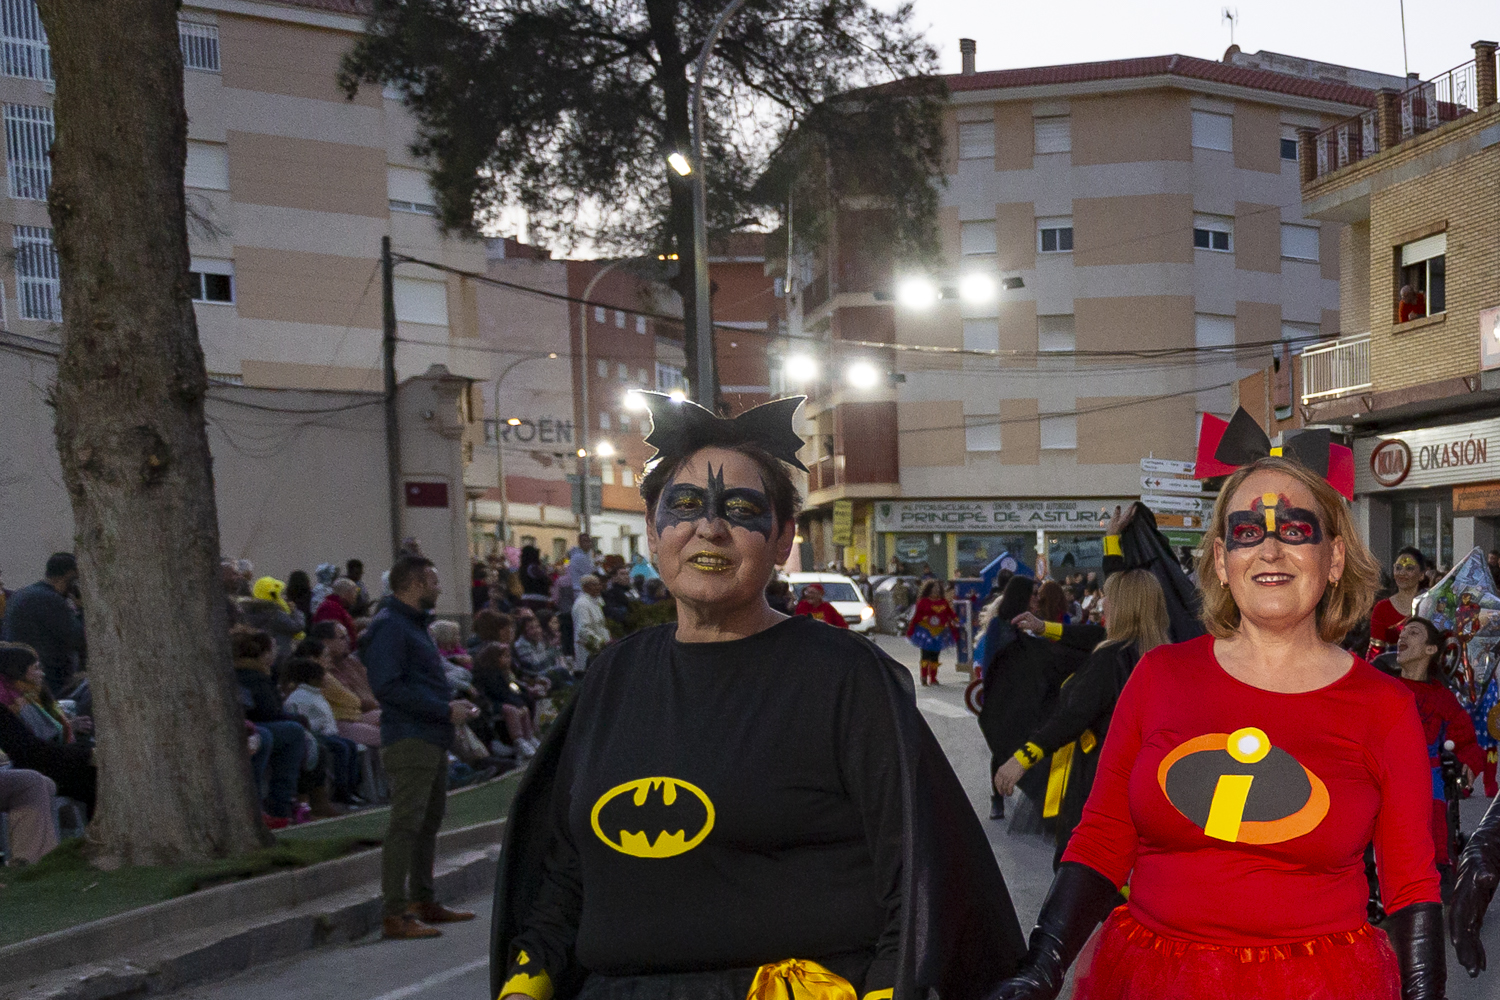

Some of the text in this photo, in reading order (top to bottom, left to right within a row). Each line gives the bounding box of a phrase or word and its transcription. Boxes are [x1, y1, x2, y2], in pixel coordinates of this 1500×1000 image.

[1377, 433, 1488, 476] KIA OKASIÓN
[901, 511, 1111, 523] PRINCIPE DE ASTURIA
